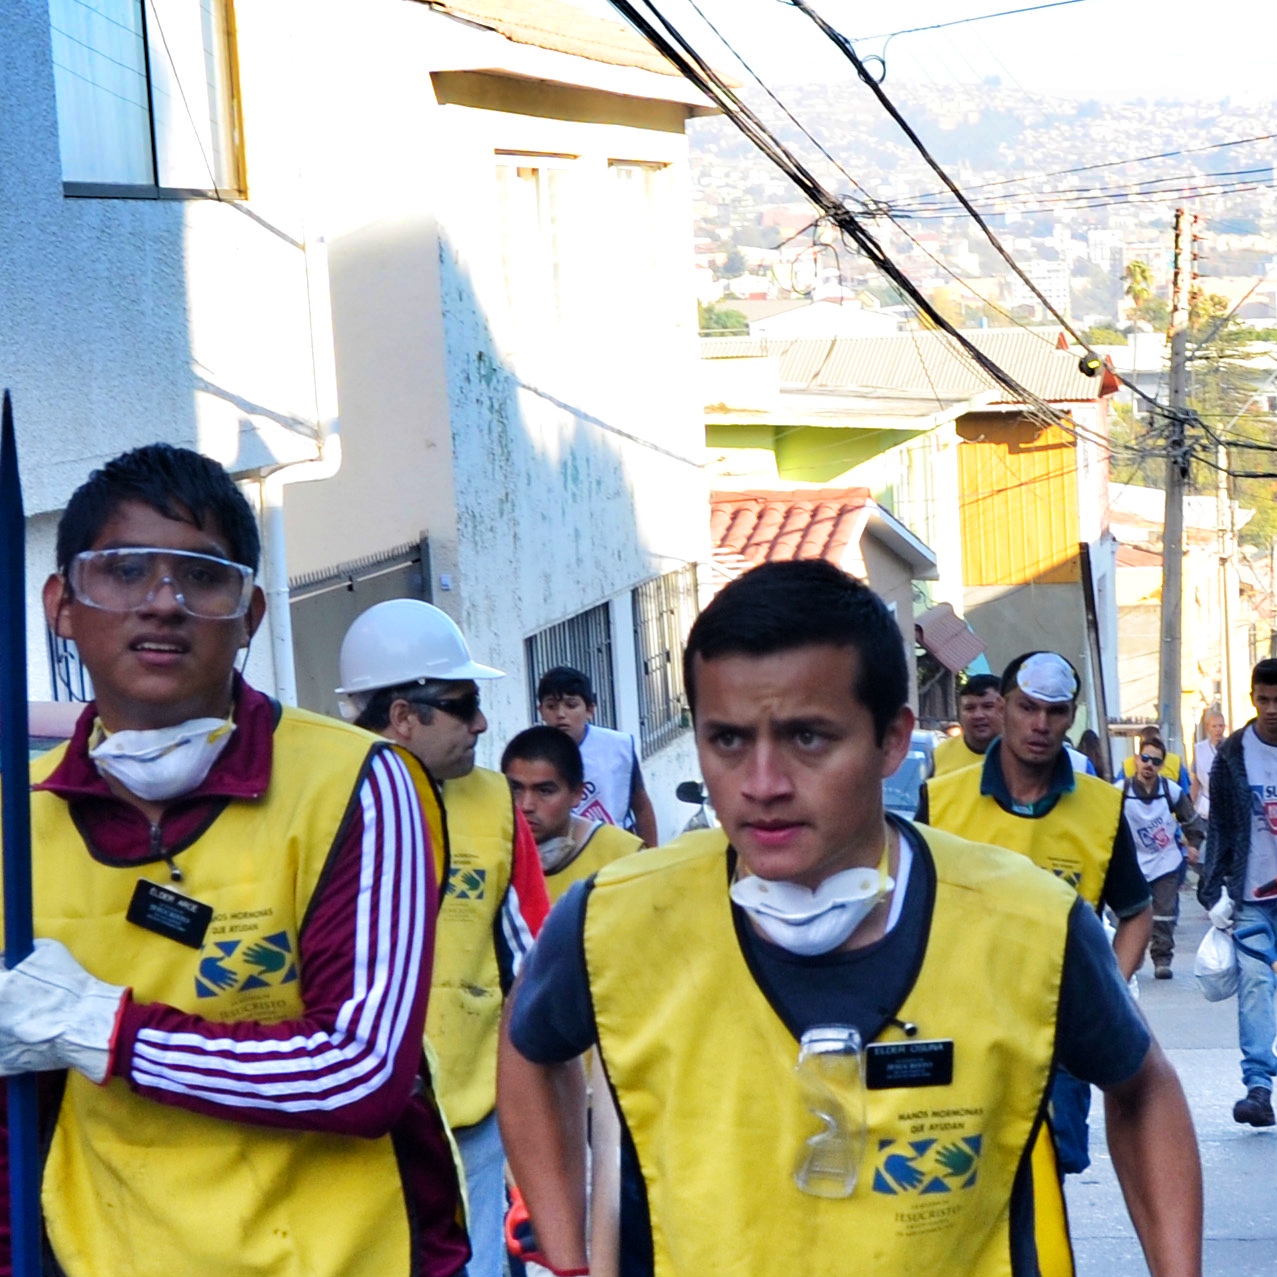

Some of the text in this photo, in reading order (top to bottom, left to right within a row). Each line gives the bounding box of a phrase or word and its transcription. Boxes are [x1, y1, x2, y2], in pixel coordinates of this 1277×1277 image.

[211, 913, 228, 921] NOS
[211, 926, 226, 934] QUE
[874, 1046, 906, 1055] ELDER
[898, 1107, 984, 1121] MANOS MORMONAS
[910, 1122, 965, 1134] QUE AYUDAN
